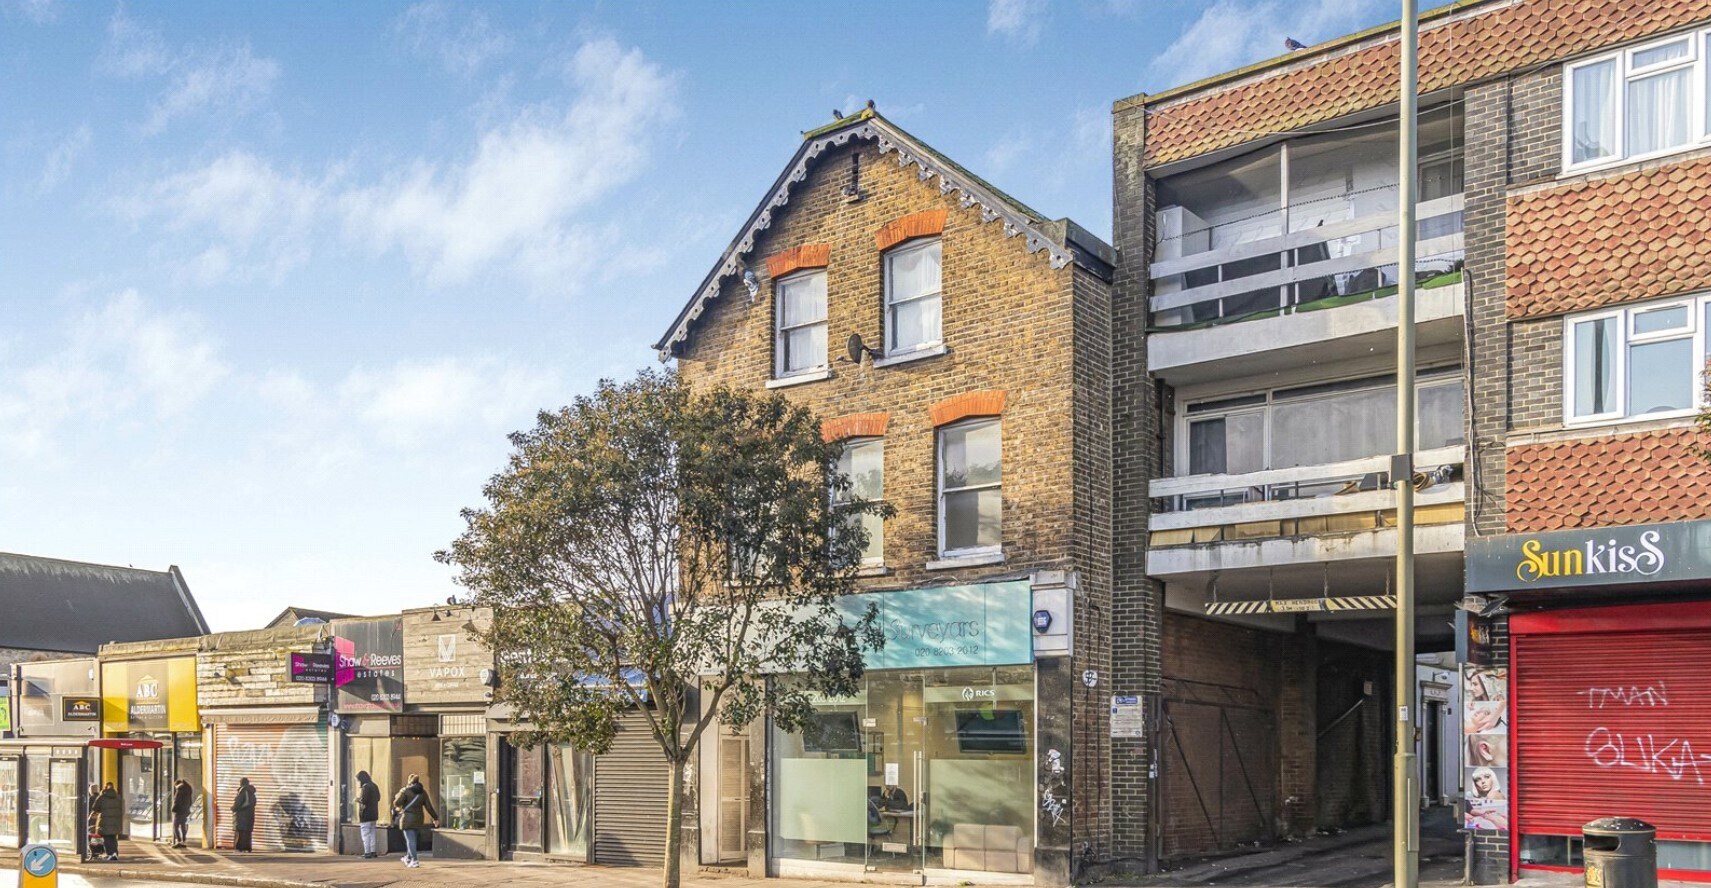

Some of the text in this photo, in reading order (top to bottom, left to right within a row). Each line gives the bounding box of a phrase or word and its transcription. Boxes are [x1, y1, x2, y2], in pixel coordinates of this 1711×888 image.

[914, 645, 979, 657] 020 8203 2012
[339, 655, 361, 668] Shaw
[370, 653, 401, 666] Reeves
[356, 670, 395, 678] estates
[429, 666, 465, 677] VAPOX
[136, 683, 158, 698] ABC
[975, 689, 995, 697] RICS
